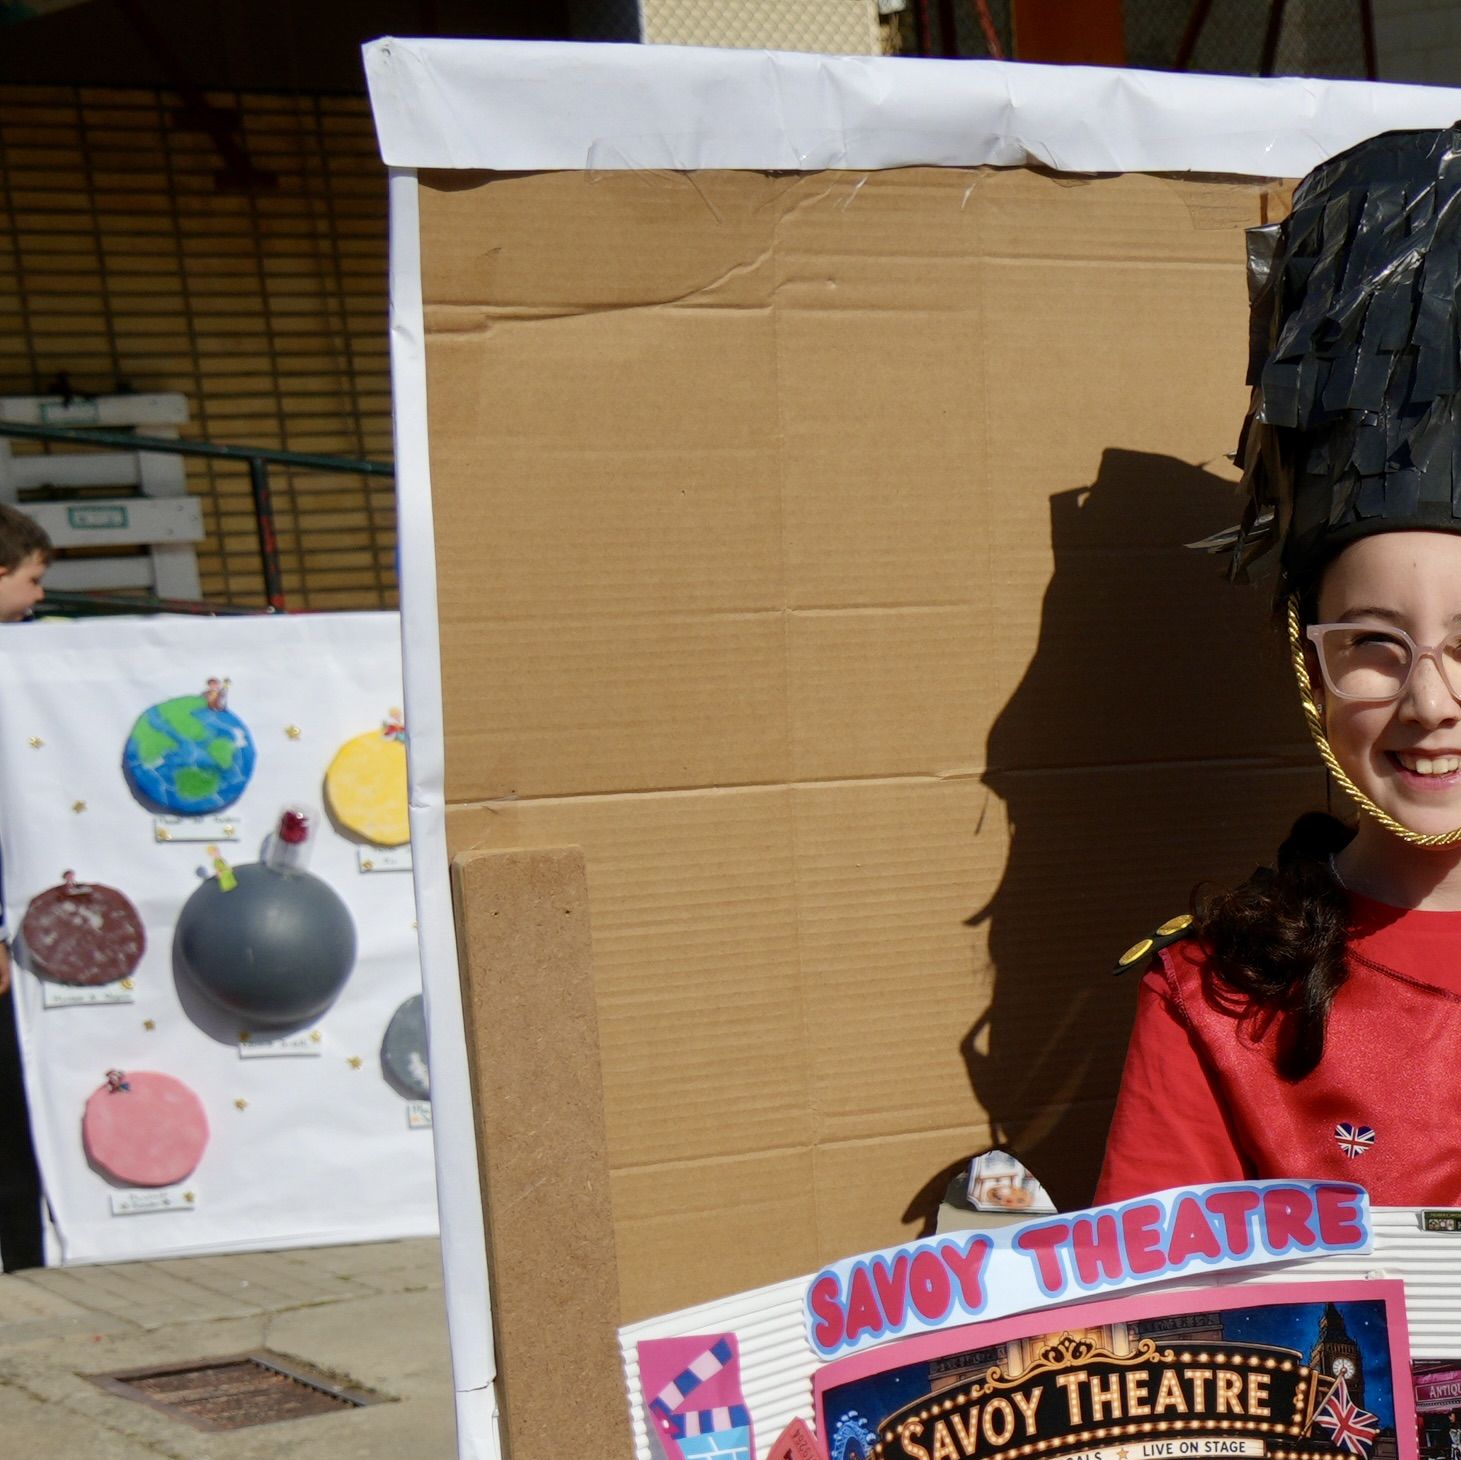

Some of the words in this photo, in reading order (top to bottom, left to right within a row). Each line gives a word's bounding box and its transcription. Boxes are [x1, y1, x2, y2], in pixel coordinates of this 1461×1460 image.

[808, 1235, 993, 1350] SAVOY
[1016, 1185, 1366, 1295] THEATRE
[1056, 1367, 1272, 1427] THEATRE
[1141, 1443, 1176, 1458] LIVE
[1178, 1441, 1201, 1455] ON
[1202, 1438, 1248, 1455] STAGE
